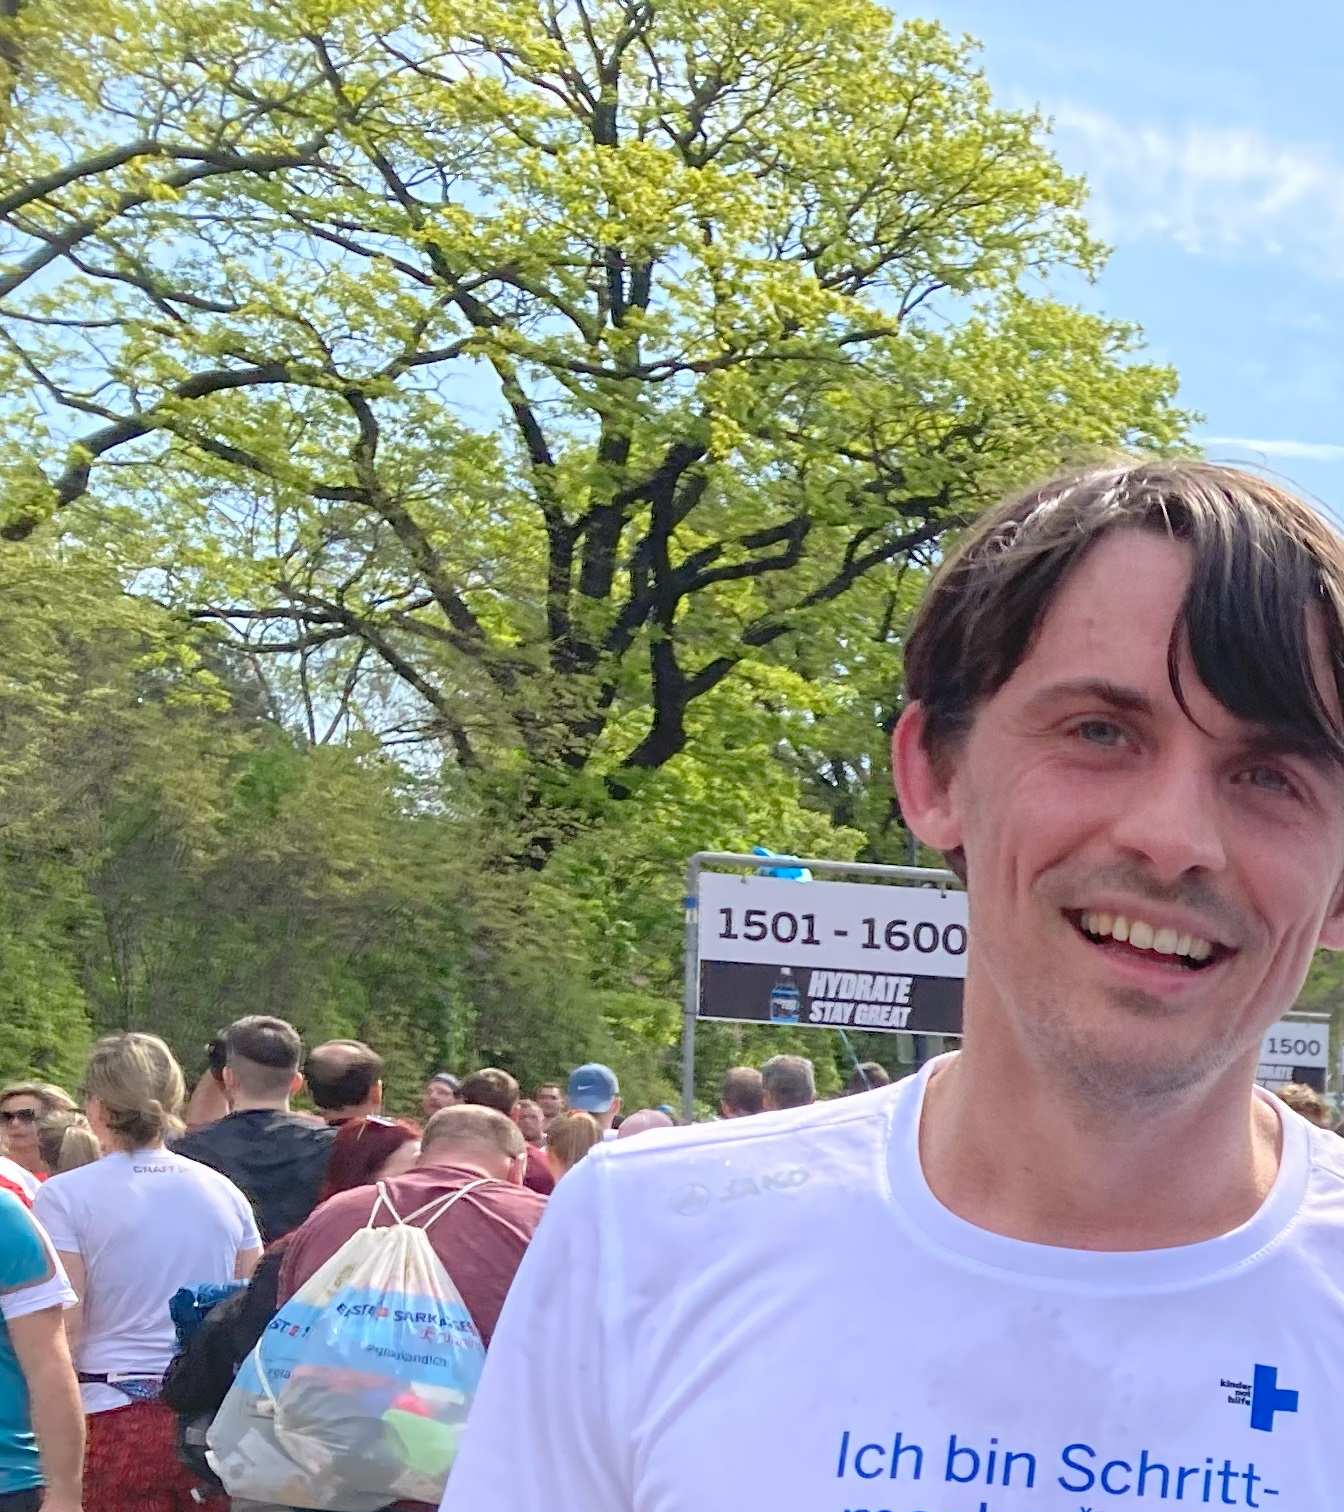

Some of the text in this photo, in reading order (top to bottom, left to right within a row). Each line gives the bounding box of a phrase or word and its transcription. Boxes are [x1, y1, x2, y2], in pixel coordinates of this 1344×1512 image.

[719, 907, 968, 956] 1501 - 1600
[807, 969, 914, 1004] HYDRATE
[809, 1000, 913, 1029] STAY GREAT
[1268, 1037, 1322, 1057] 1500
[1220, 1378, 1253, 1390] kinder
[836, 1430, 1280, 1509] Ich bin Schritt-
